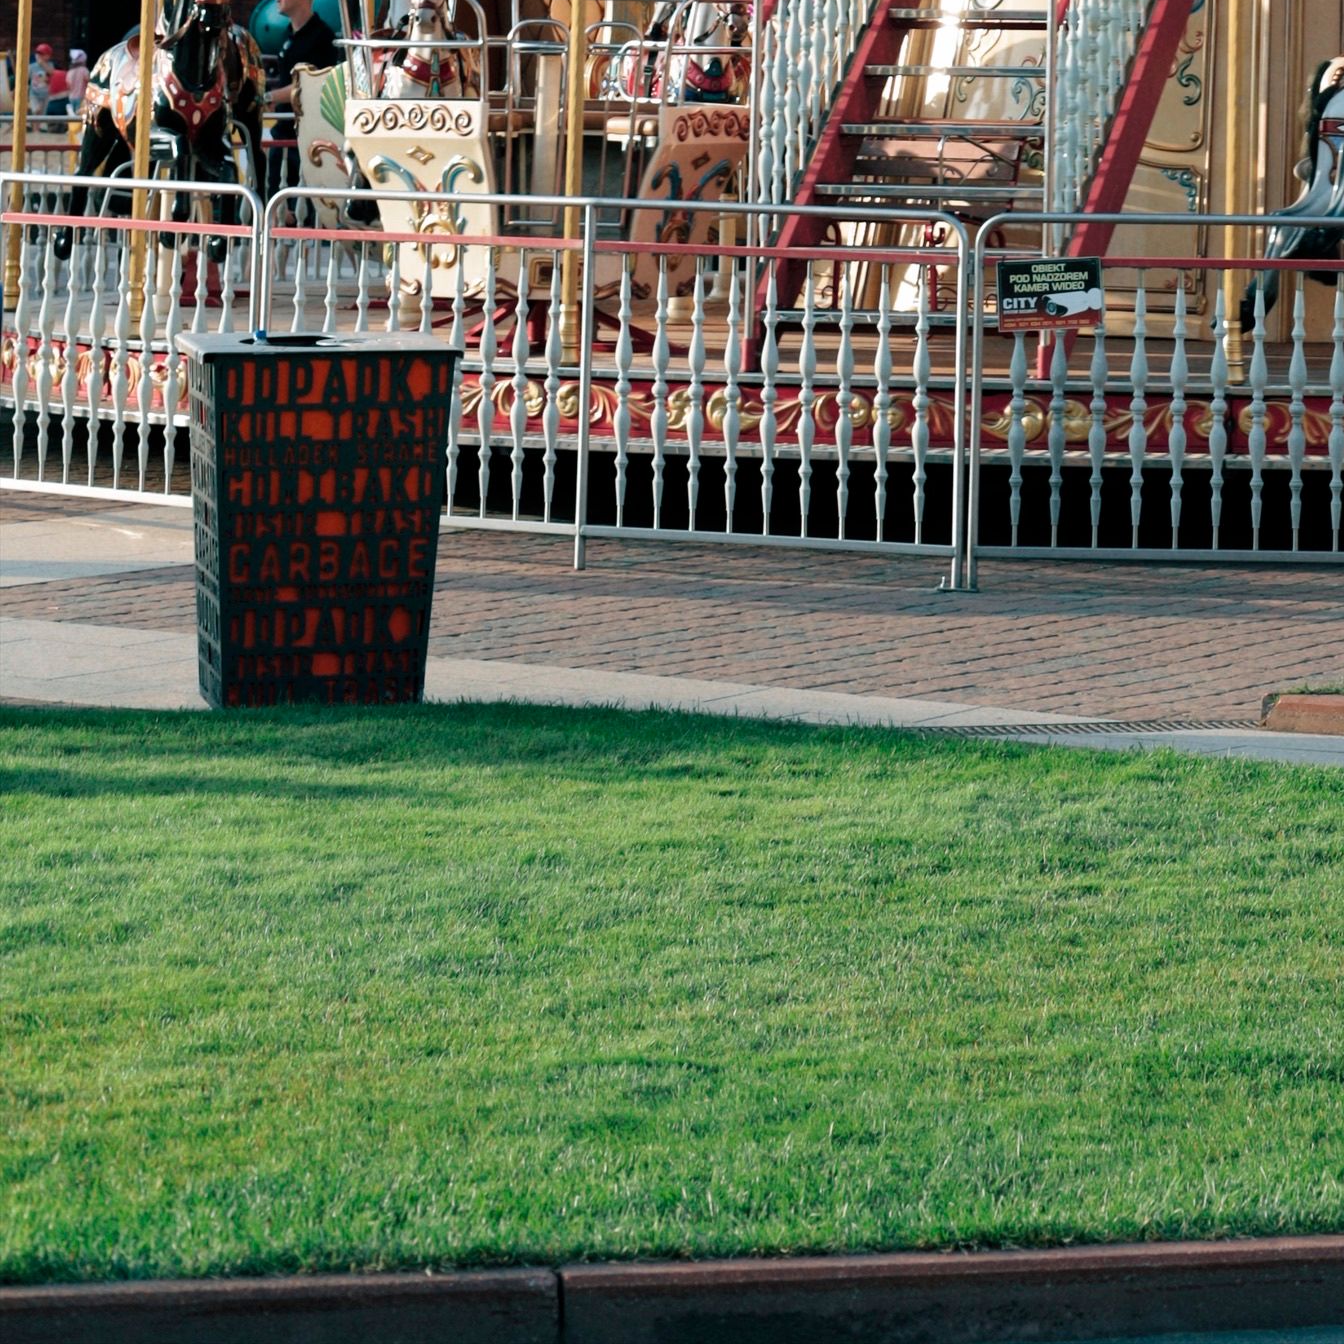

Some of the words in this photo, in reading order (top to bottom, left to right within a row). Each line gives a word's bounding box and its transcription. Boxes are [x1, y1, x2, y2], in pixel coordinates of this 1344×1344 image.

[1031, 263, 1066, 272] OBIEKT
[1009, 274, 1030, 283] POD
[1033, 272, 1088, 282] NADZOREM
[1014, 282, 1050, 292] KAMER
[1052, 281, 1085, 291] WIDEO
[1003, 297, 1038, 309] CITY
[228, 537, 430, 584] GARBAGE
